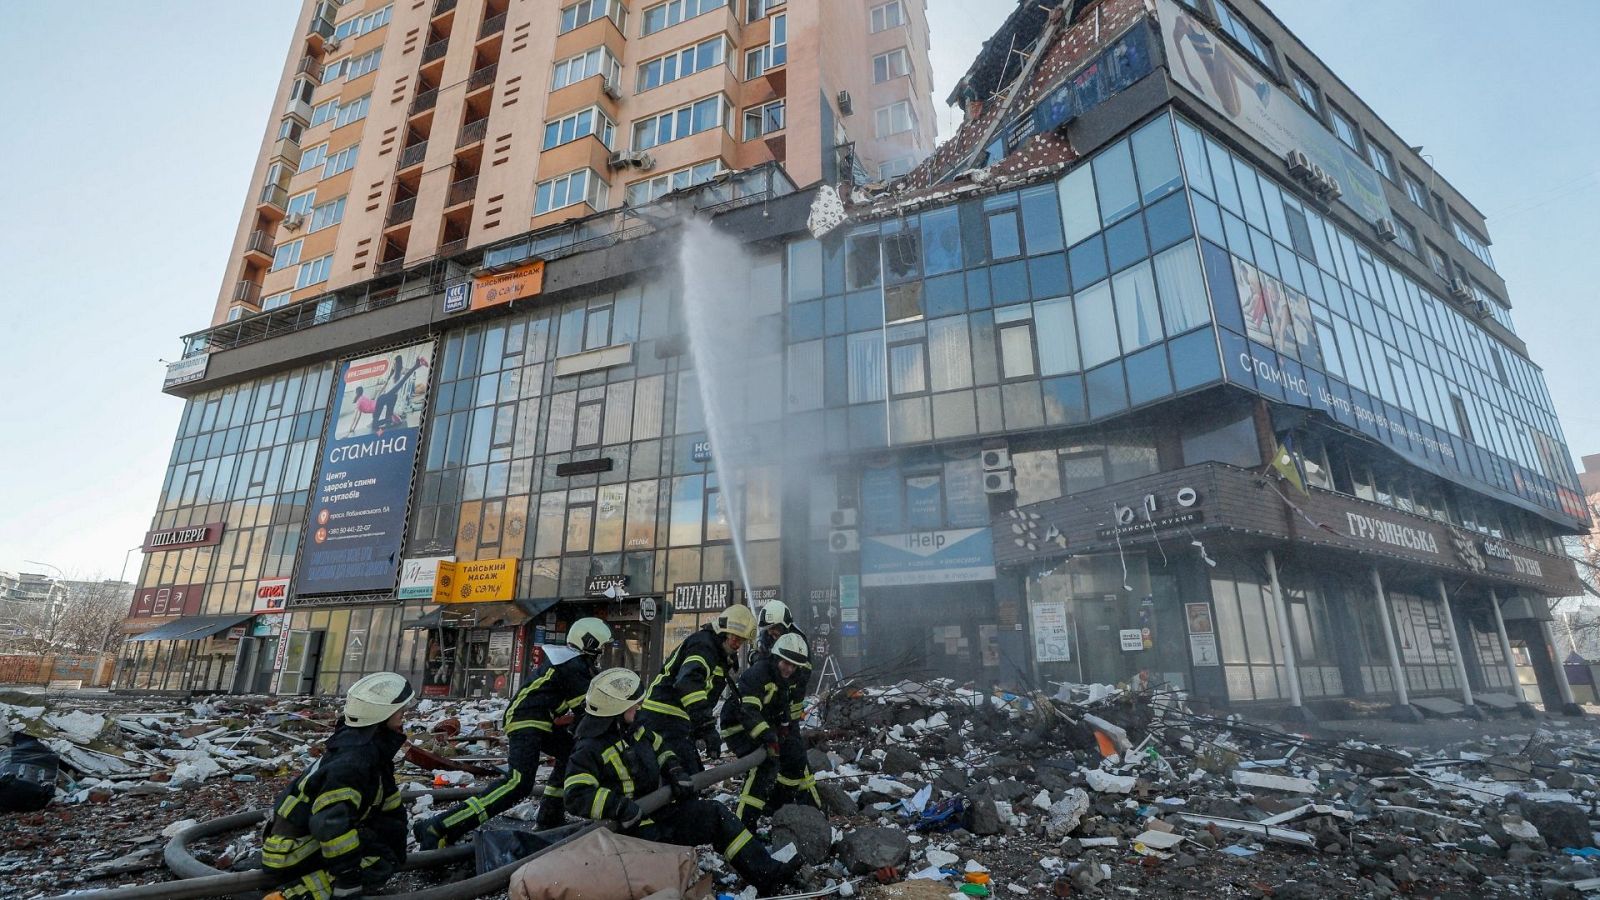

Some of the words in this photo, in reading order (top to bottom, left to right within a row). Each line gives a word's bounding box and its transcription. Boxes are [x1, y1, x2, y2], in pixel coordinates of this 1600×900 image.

[513, 268, 540, 279] МАСАЖ
[326, 471, 347, 481] Центр
[324, 480, 353, 492] здоров'я
[354, 478, 376, 487] спини
[330, 490, 360, 503] суглобів
[1162, 514, 1193, 525] КУХНЯ
[151, 527, 207, 547] ШПАЛЕРИ
[1346, 512, 1439, 554] ГРУЗИНСЬКА
[463, 562, 506, 573] ТАЙСЬКИЙ
[1512, 554, 1543, 577] КУХНЯ
[467, 572, 498, 581] МАСАЖ
[675, 585, 703, 610] COZY
[705, 584, 727, 609] BAR
